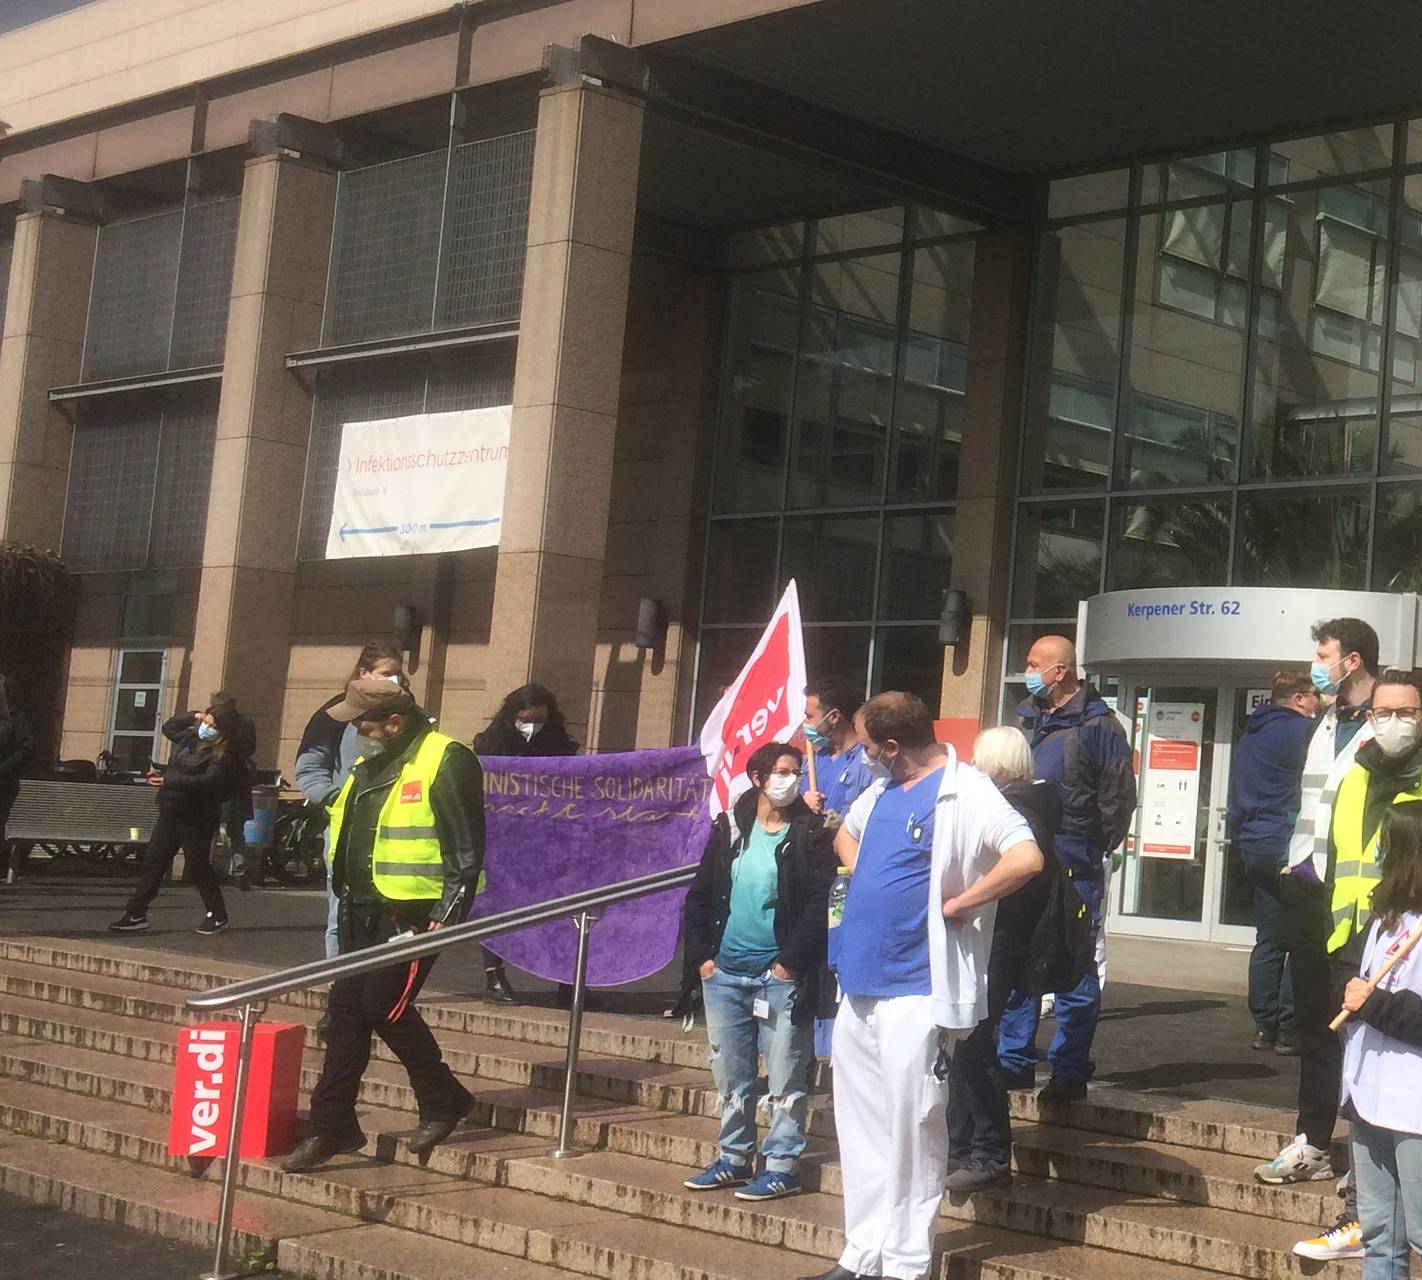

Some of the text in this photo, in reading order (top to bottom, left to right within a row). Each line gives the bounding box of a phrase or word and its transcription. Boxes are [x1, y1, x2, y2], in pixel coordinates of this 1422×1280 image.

[1128, 601, 1240, 619] Kerpener Str. 62
[483, 772, 713, 801] INISTISCHE SOLIDARITÄT
[187, 1029, 226, 1155] ver.di
